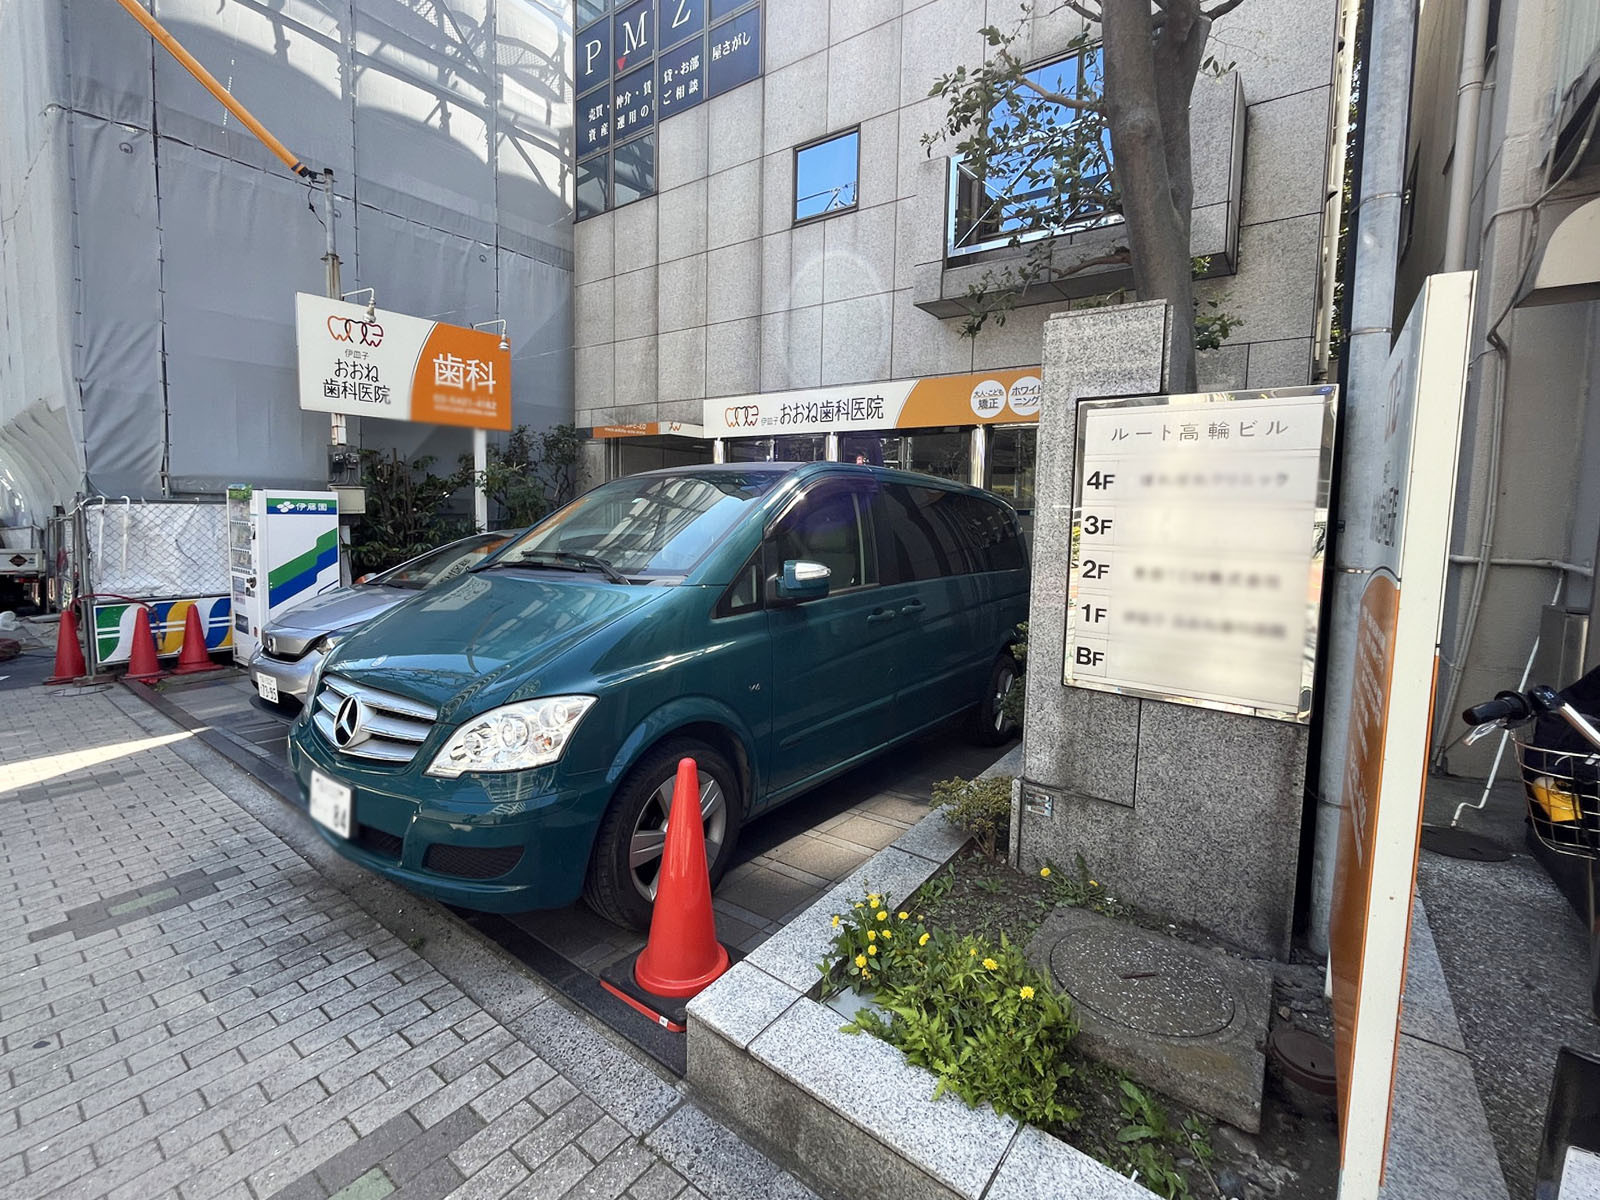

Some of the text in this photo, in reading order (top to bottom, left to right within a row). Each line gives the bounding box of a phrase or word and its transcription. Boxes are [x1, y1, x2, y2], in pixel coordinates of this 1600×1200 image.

[334, 358, 379, 383] おおね
[432, 352, 497, 395] 歯科
[323, 378, 391, 405] 歯科医院
[780, 394, 884, 425] おおね歯科医院
[978, 398, 999, 410] 矯正
[1111, 420, 1289, 442] ルート高輪ビル
[1086, 471, 1116, 491] 4F
[1084, 515, 1113, 536] 3F
[1082, 560, 1110, 580] 2F
[1081, 604, 1107, 624] 1F
[1076, 646, 1105, 667] BF
